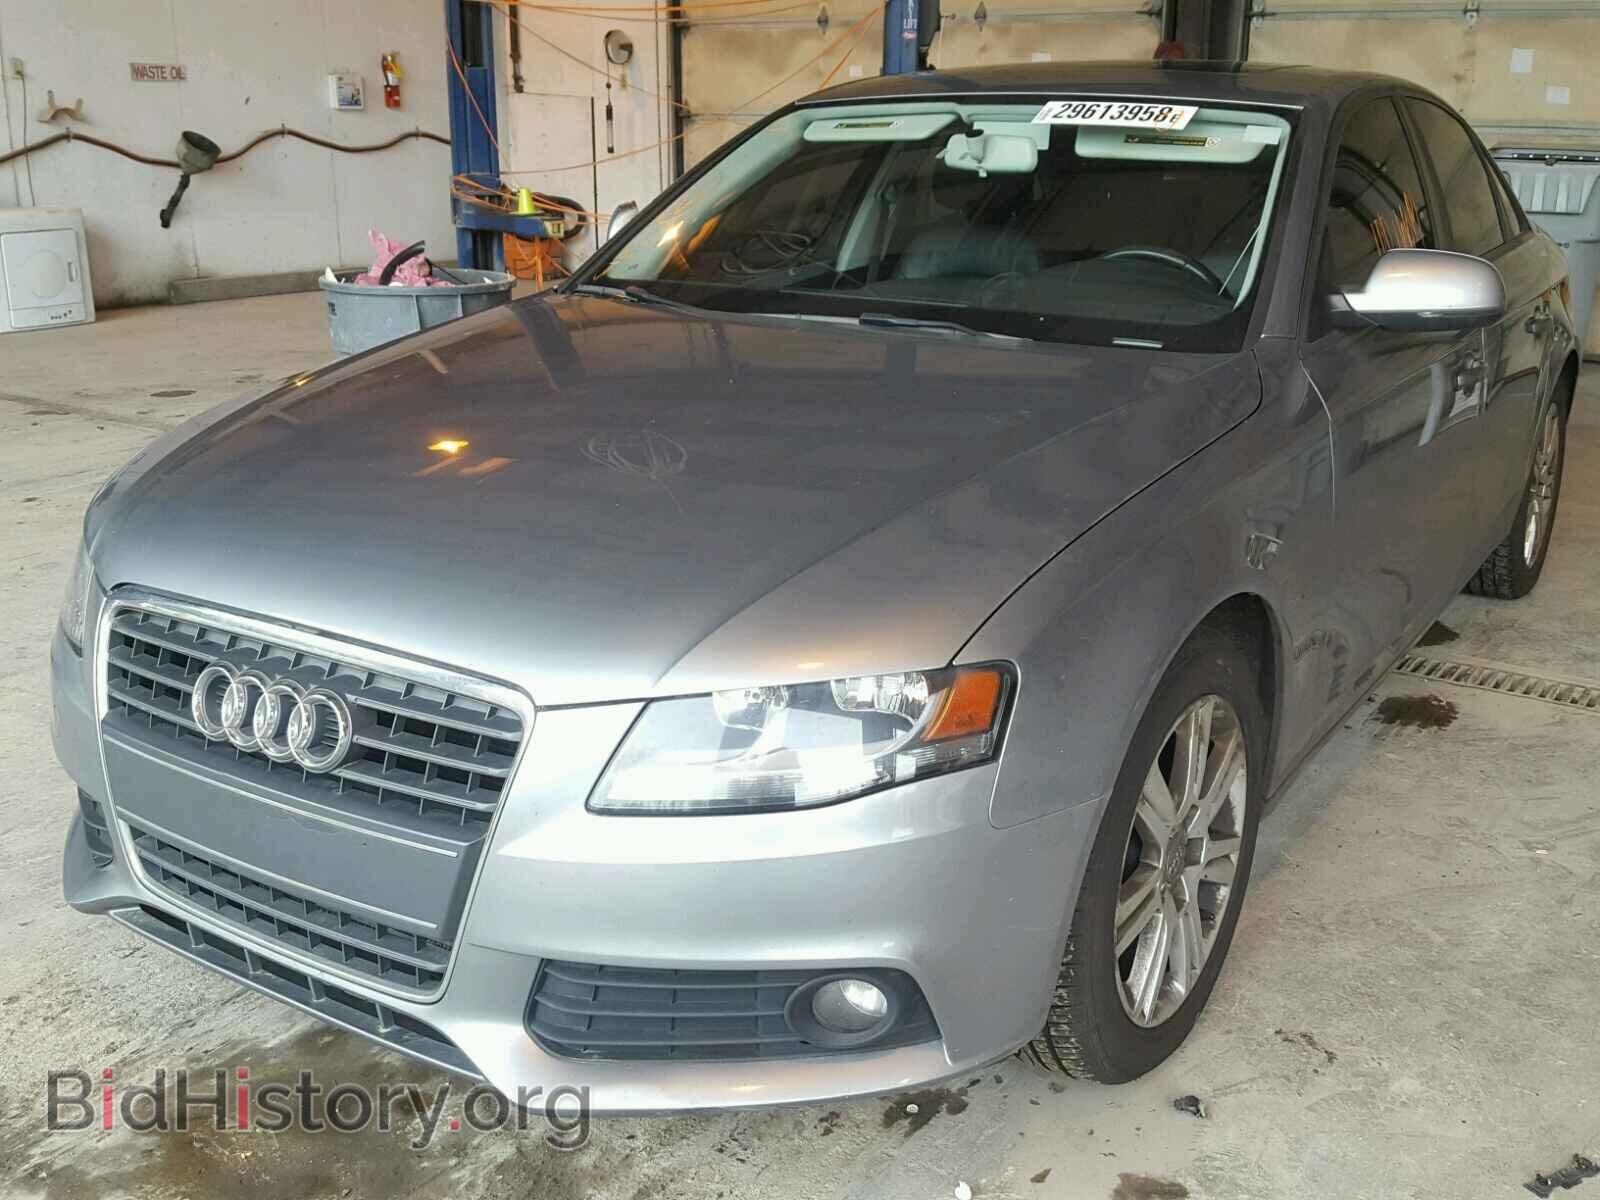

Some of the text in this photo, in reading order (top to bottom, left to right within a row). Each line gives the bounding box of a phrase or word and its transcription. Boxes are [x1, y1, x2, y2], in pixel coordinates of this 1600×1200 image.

[133, 65, 186, 80] WASTE OIL
[1052, 103, 1173, 123] 29613958
